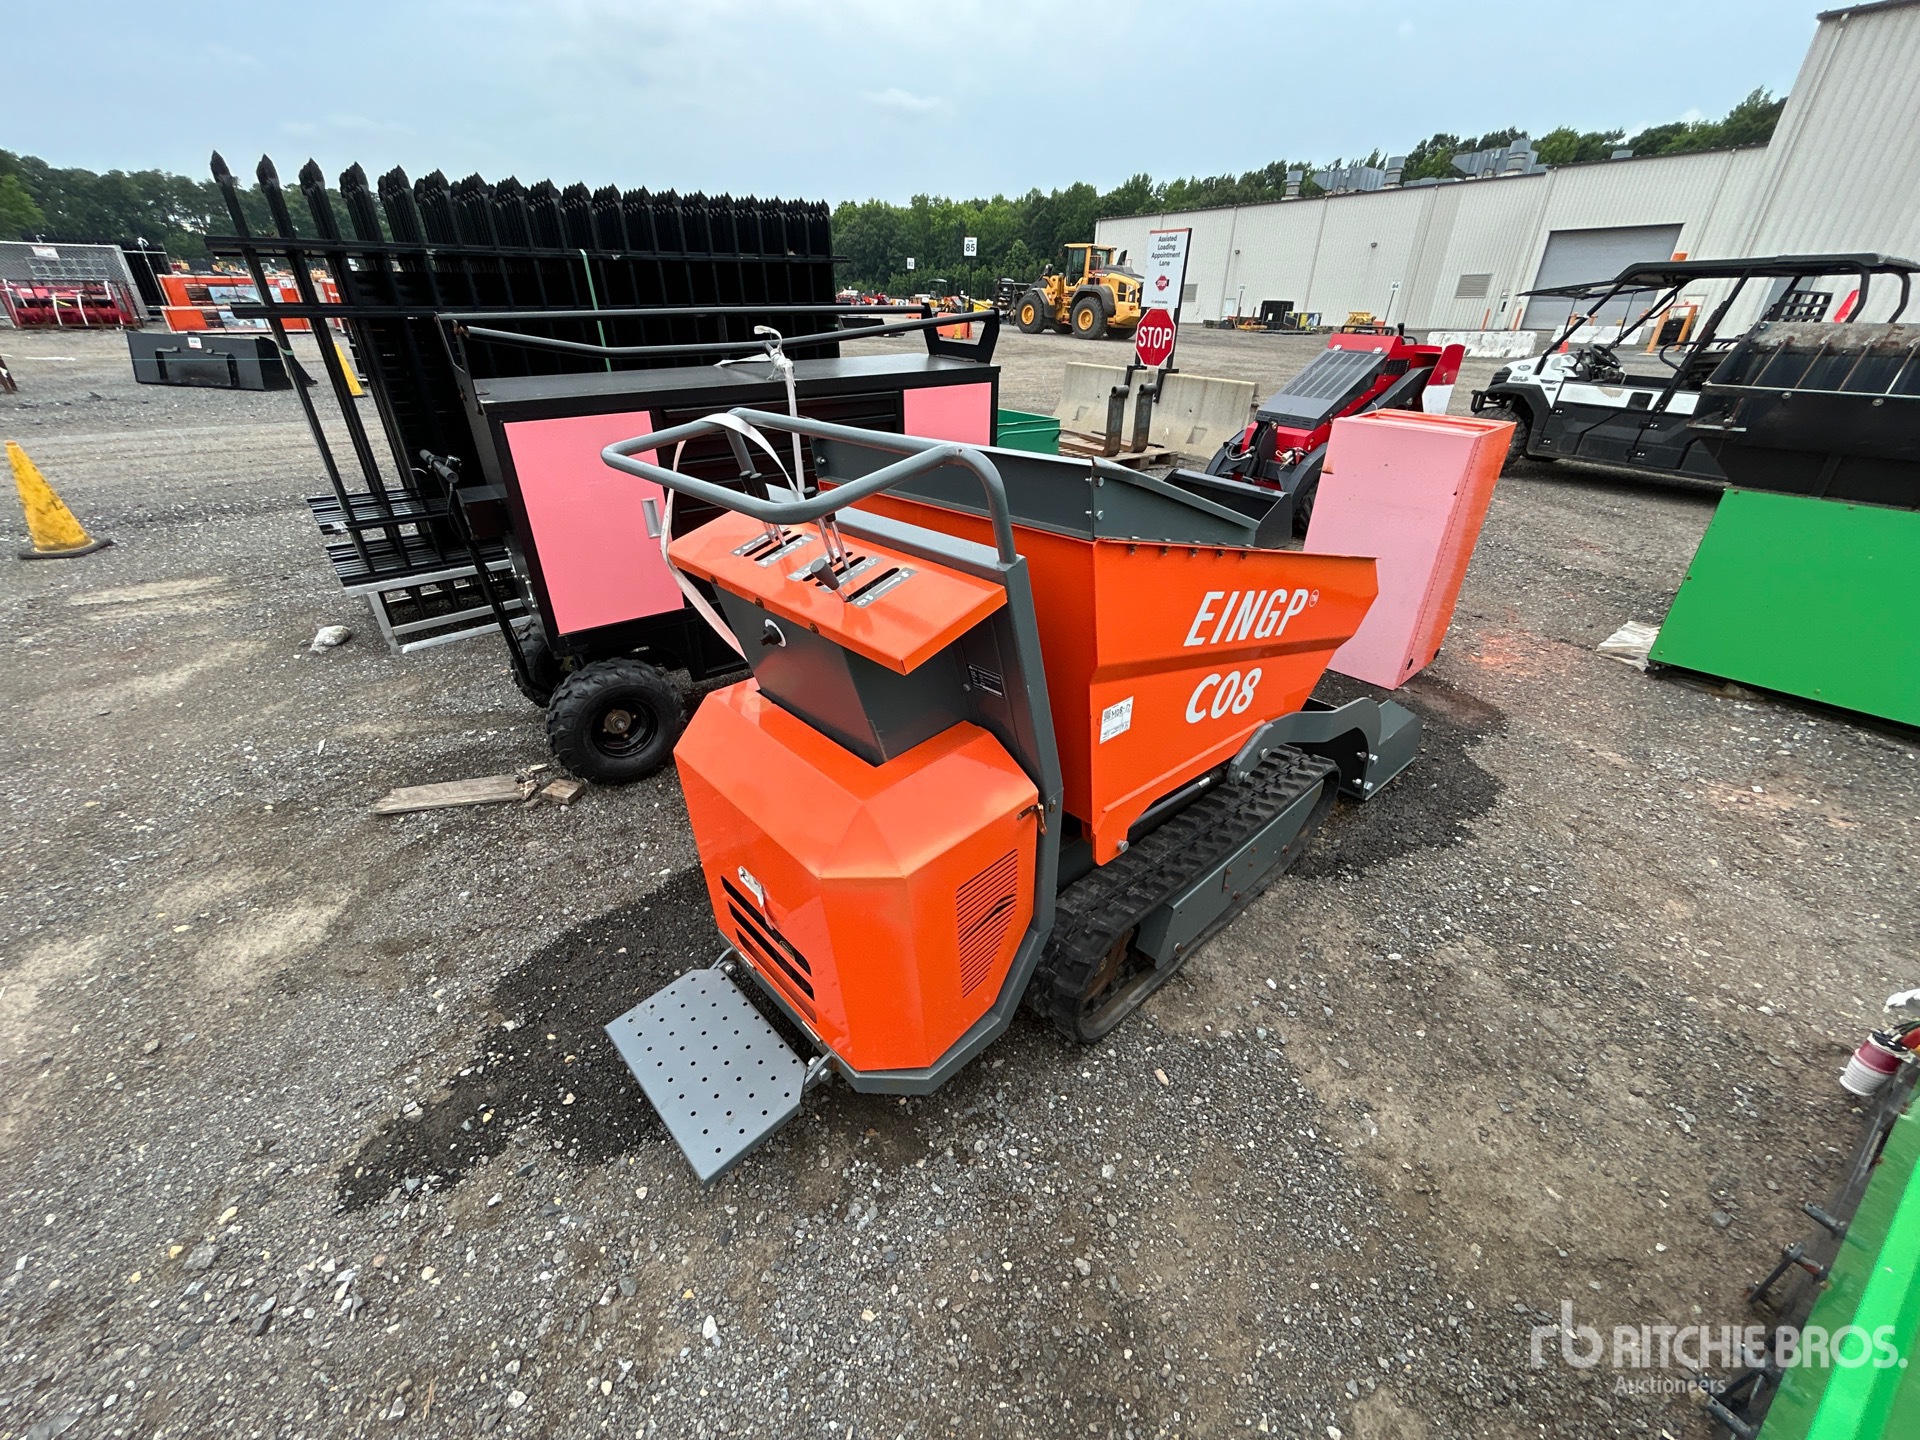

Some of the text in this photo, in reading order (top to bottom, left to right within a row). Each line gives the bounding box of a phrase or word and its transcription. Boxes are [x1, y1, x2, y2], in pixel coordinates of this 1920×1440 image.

[965, 243, 976, 252] 85
[1151, 251, 1181, 260] Appointment
[1138, 326, 1172, 349] STOP
[1183, 588, 1309, 647] EINGP
